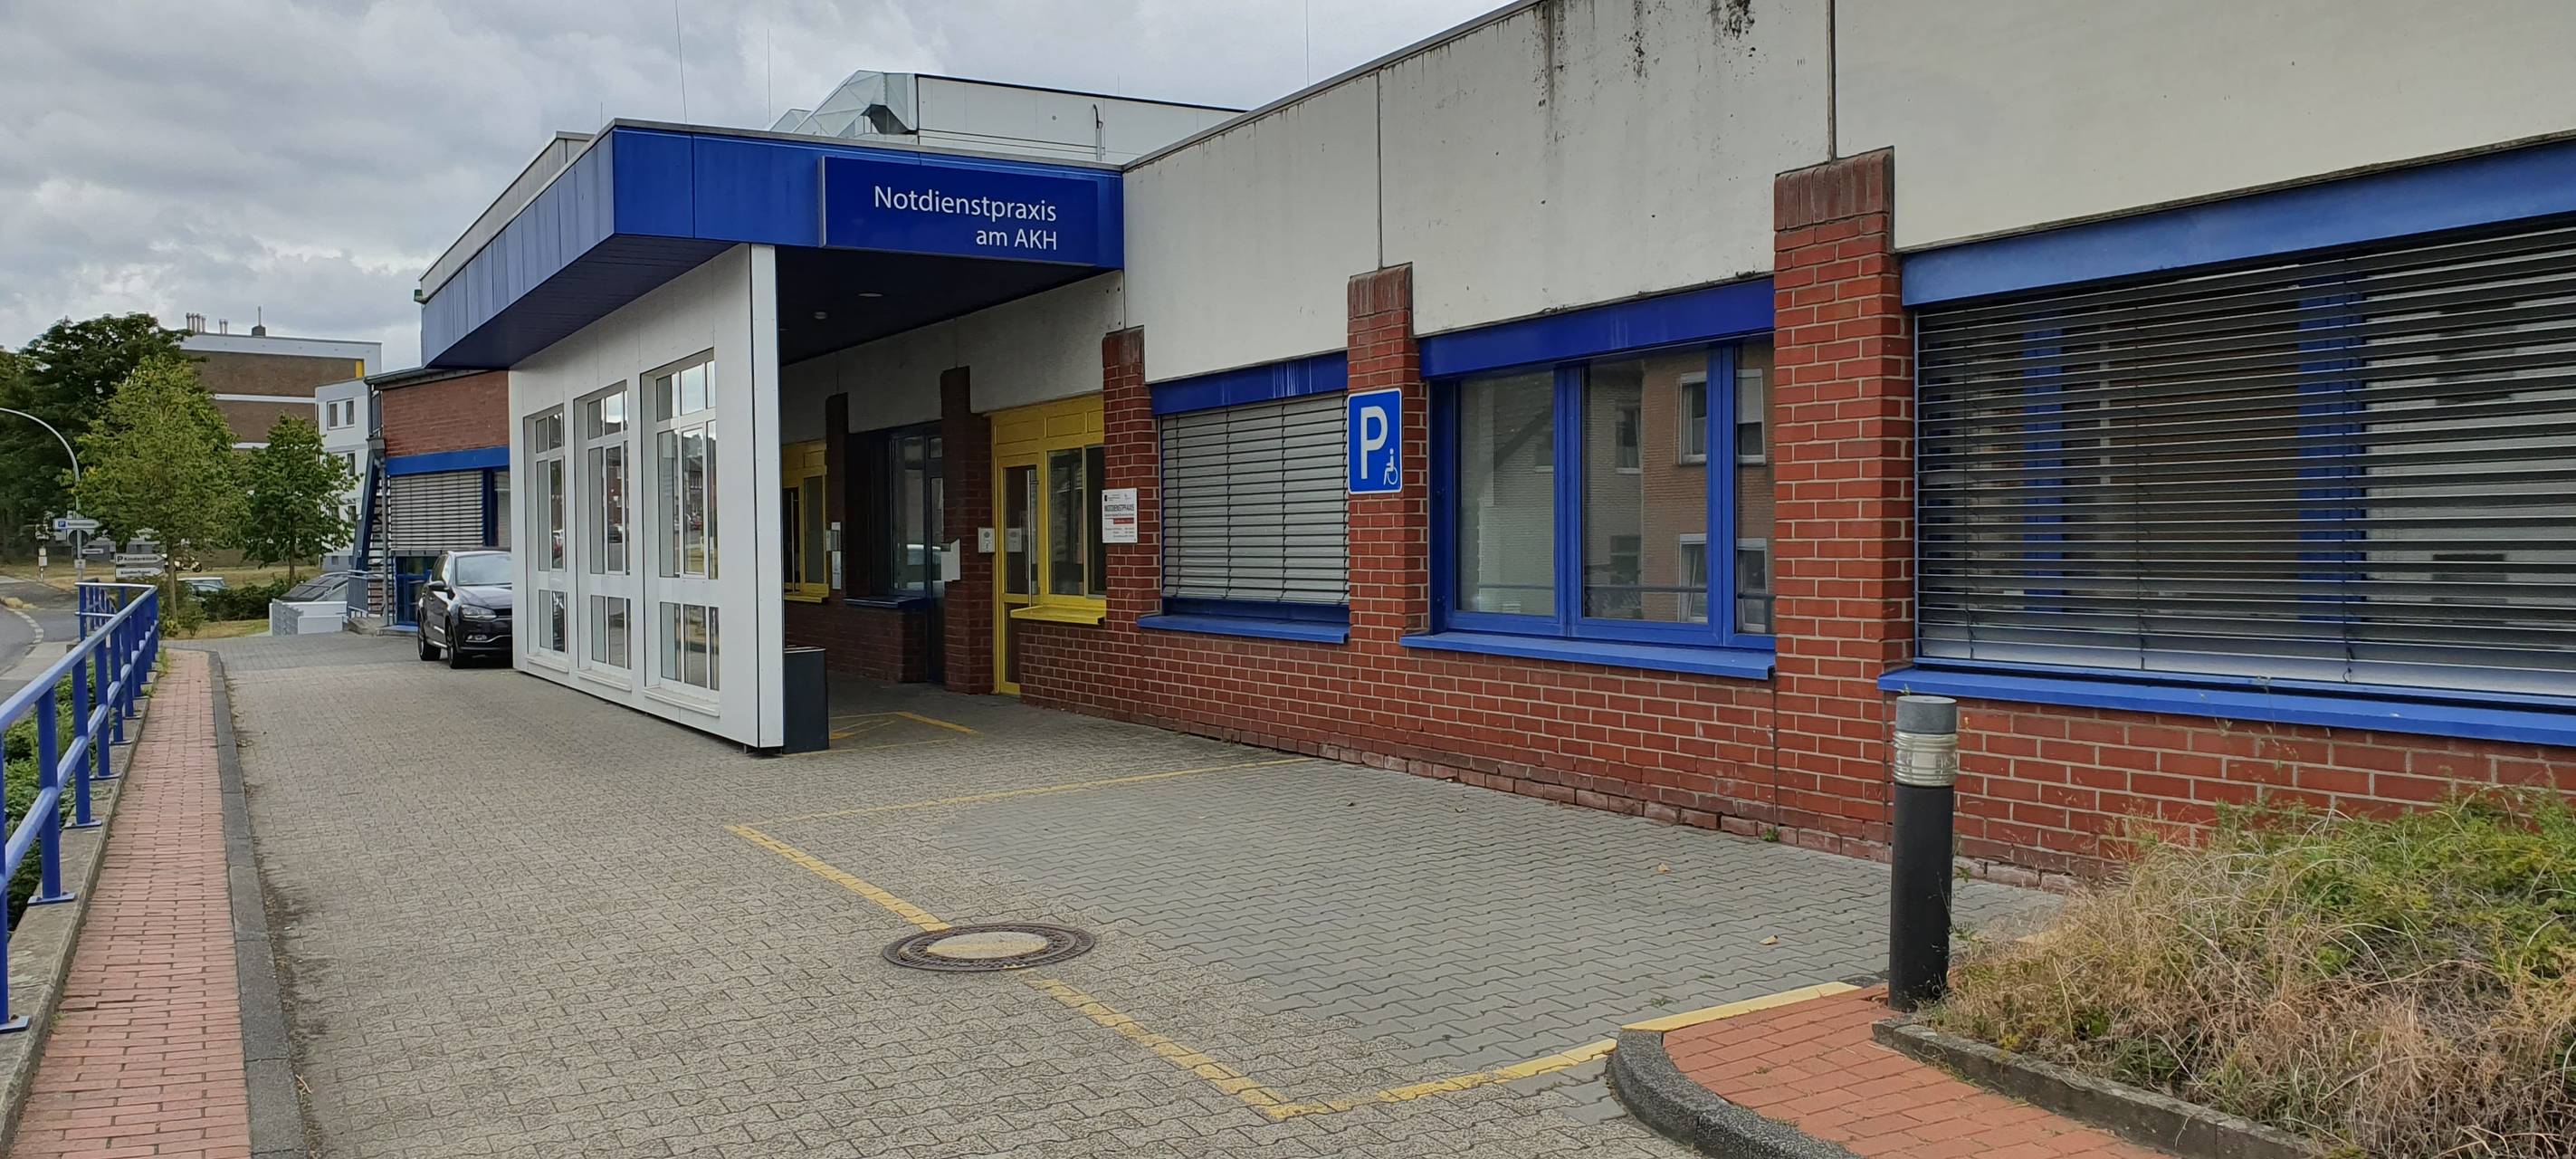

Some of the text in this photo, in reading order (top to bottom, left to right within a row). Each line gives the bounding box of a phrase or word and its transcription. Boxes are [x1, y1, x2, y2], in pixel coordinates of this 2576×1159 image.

[873, 185, 1057, 223] Notdienstpraxis
[976, 228, 1057, 251] am AKH
[1360, 405, 1388, 480] P
